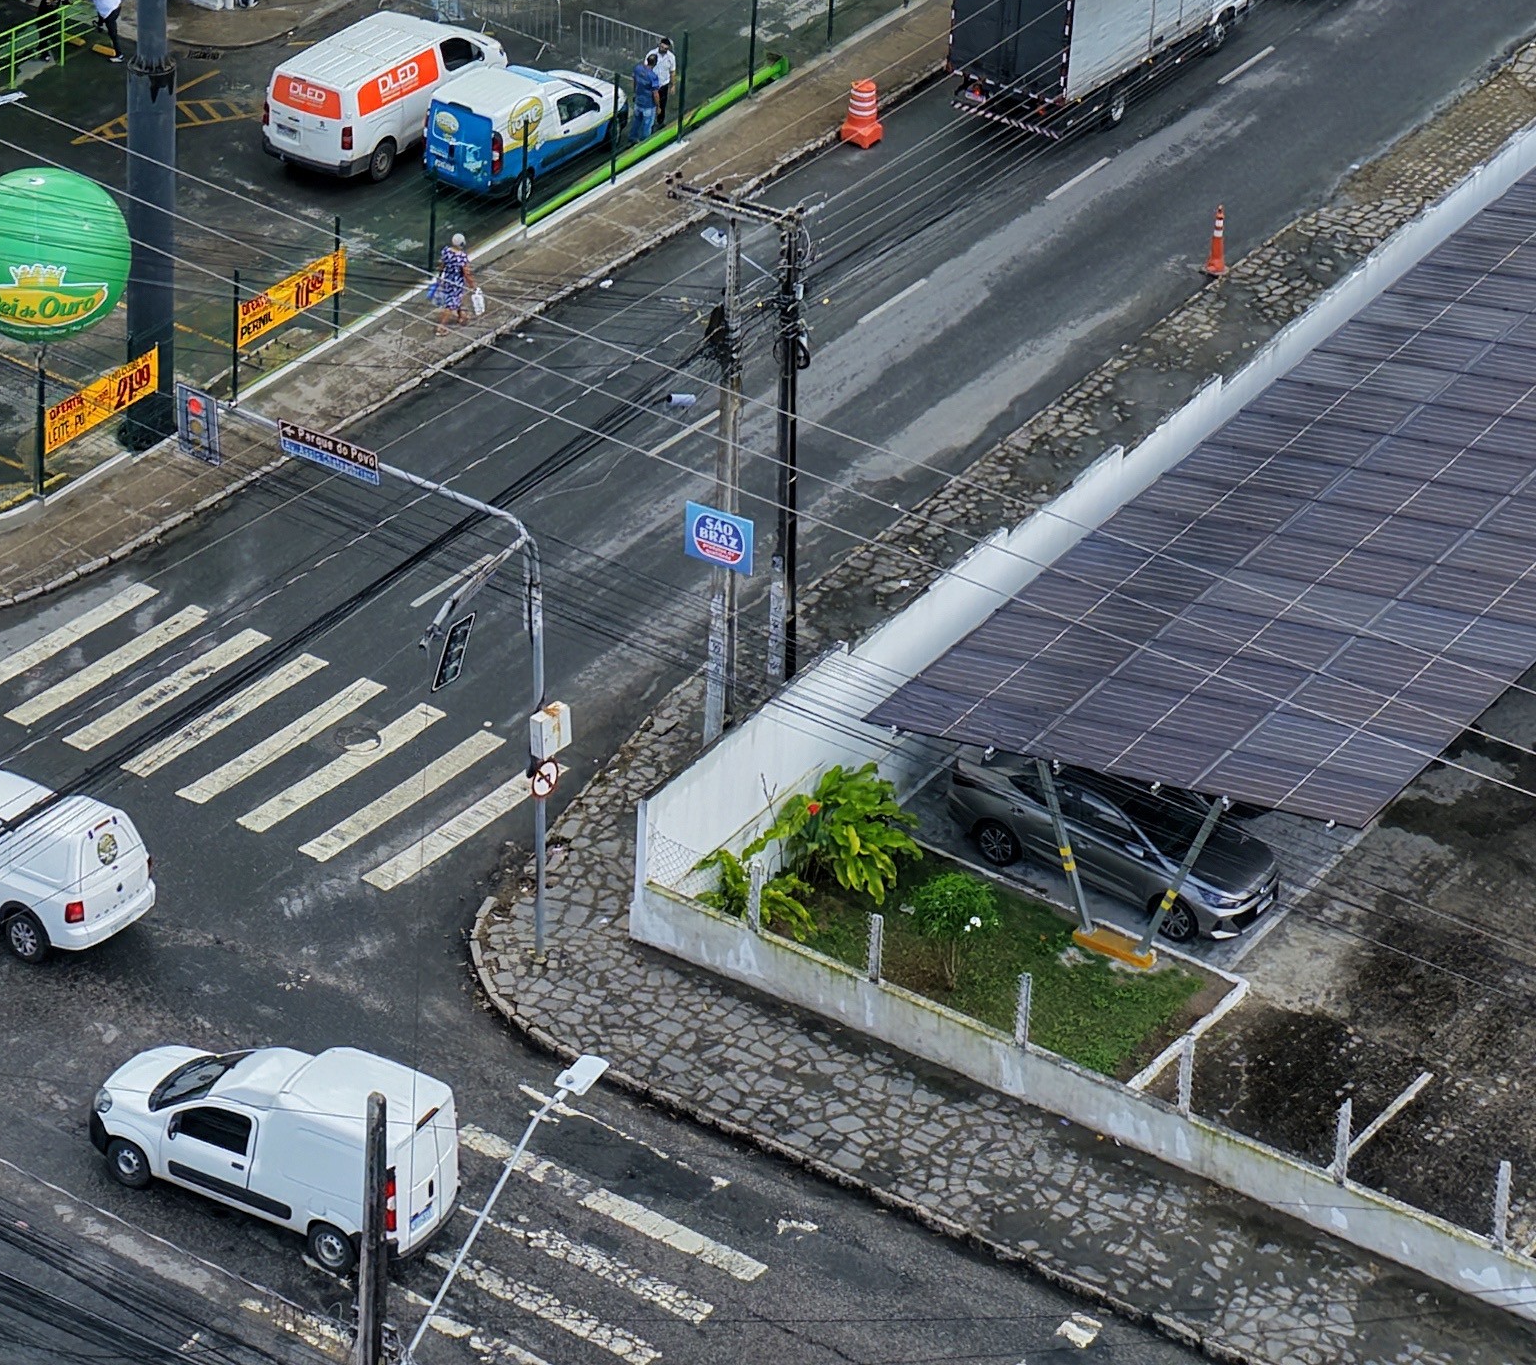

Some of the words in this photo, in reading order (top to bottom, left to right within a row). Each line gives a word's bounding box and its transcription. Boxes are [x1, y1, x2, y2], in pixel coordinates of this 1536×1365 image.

[377, 61, 418, 93] DLED
[289, 81, 325, 102] DLED
[19, 303, 36, 317] de
[38, 294, 95, 318] Ouro
[239, 313, 273, 339] PERNIL
[47, 419, 71, 445] LEITE
[298, 428, 333, 451] Parque
[337, 441, 348, 455] do
[350, 446, 374, 467] Povo
[699, 527, 738, 549] BRAZ
[705, 516, 733, 536] SÃO
